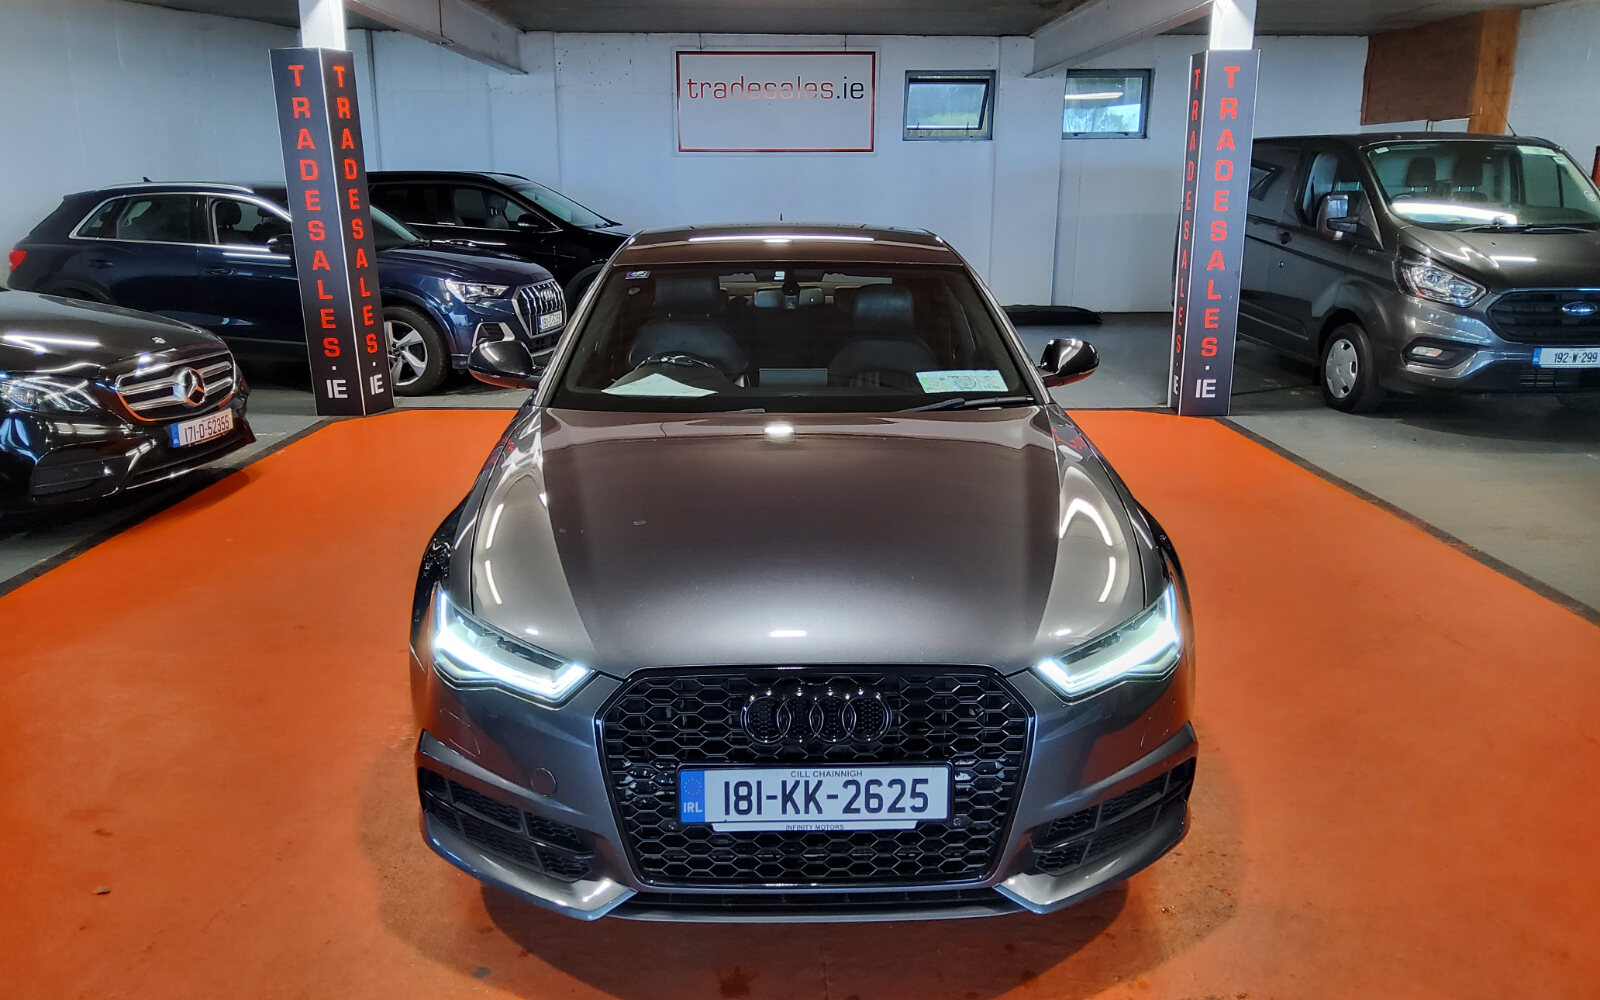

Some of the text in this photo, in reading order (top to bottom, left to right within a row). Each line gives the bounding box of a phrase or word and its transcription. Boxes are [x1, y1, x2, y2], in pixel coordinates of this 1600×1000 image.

[686, 75, 865, 100] tradesales.ie
[184, 414, 230, 443] 171-D-52355
[790, 769, 863, 778] CILL CHAINNIGH
[683, 801, 703, 814] IRL
[724, 778, 929, 816] 181-KK-2625
